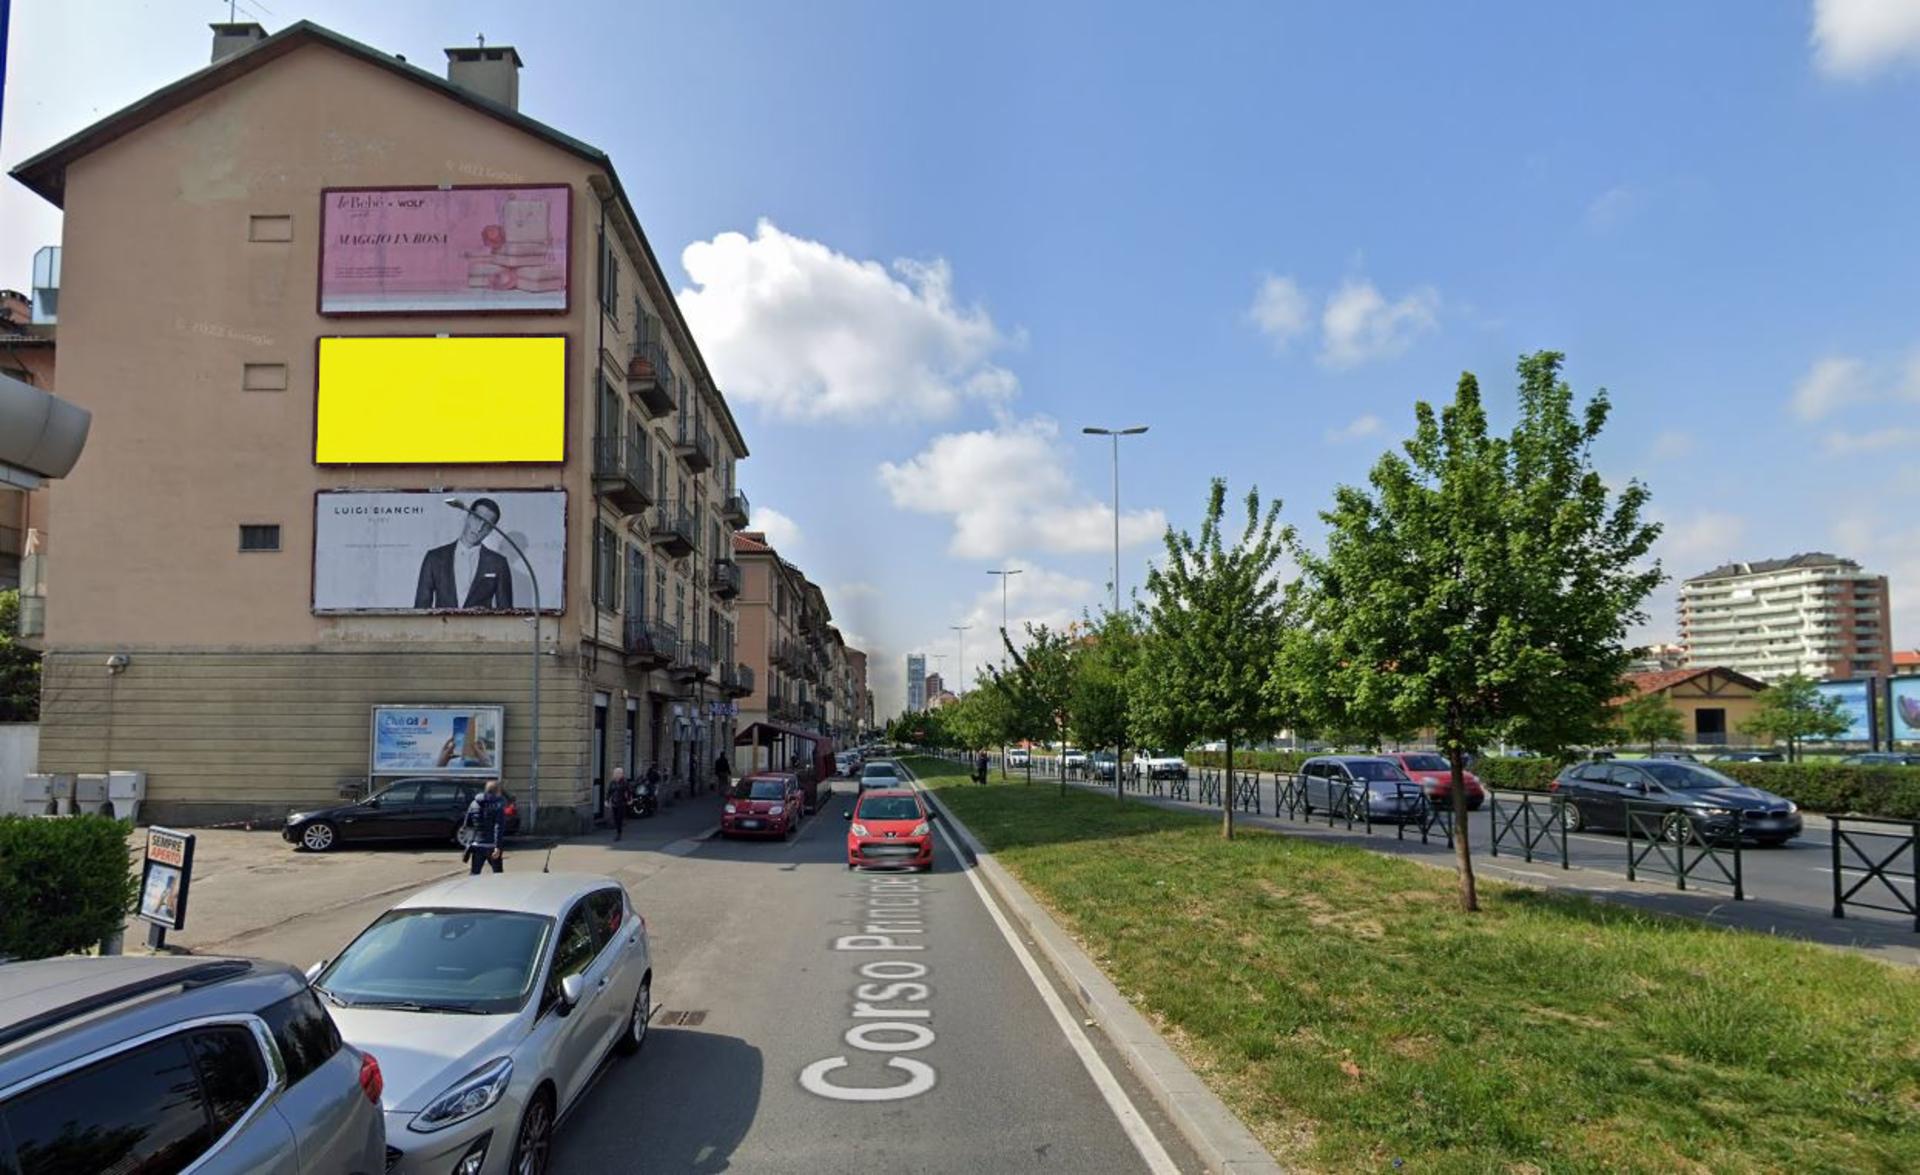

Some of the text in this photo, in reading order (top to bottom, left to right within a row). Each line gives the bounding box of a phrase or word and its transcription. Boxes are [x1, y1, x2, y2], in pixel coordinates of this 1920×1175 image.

[398, 199, 425, 208] WOLF
[339, 233, 448, 246] MAGGIO IN ROSA
[334, 506, 424, 515] LUIGI BIANCHI
[152, 835, 182, 852] SEMPRE
[150, 847, 181, 864] APERTO
